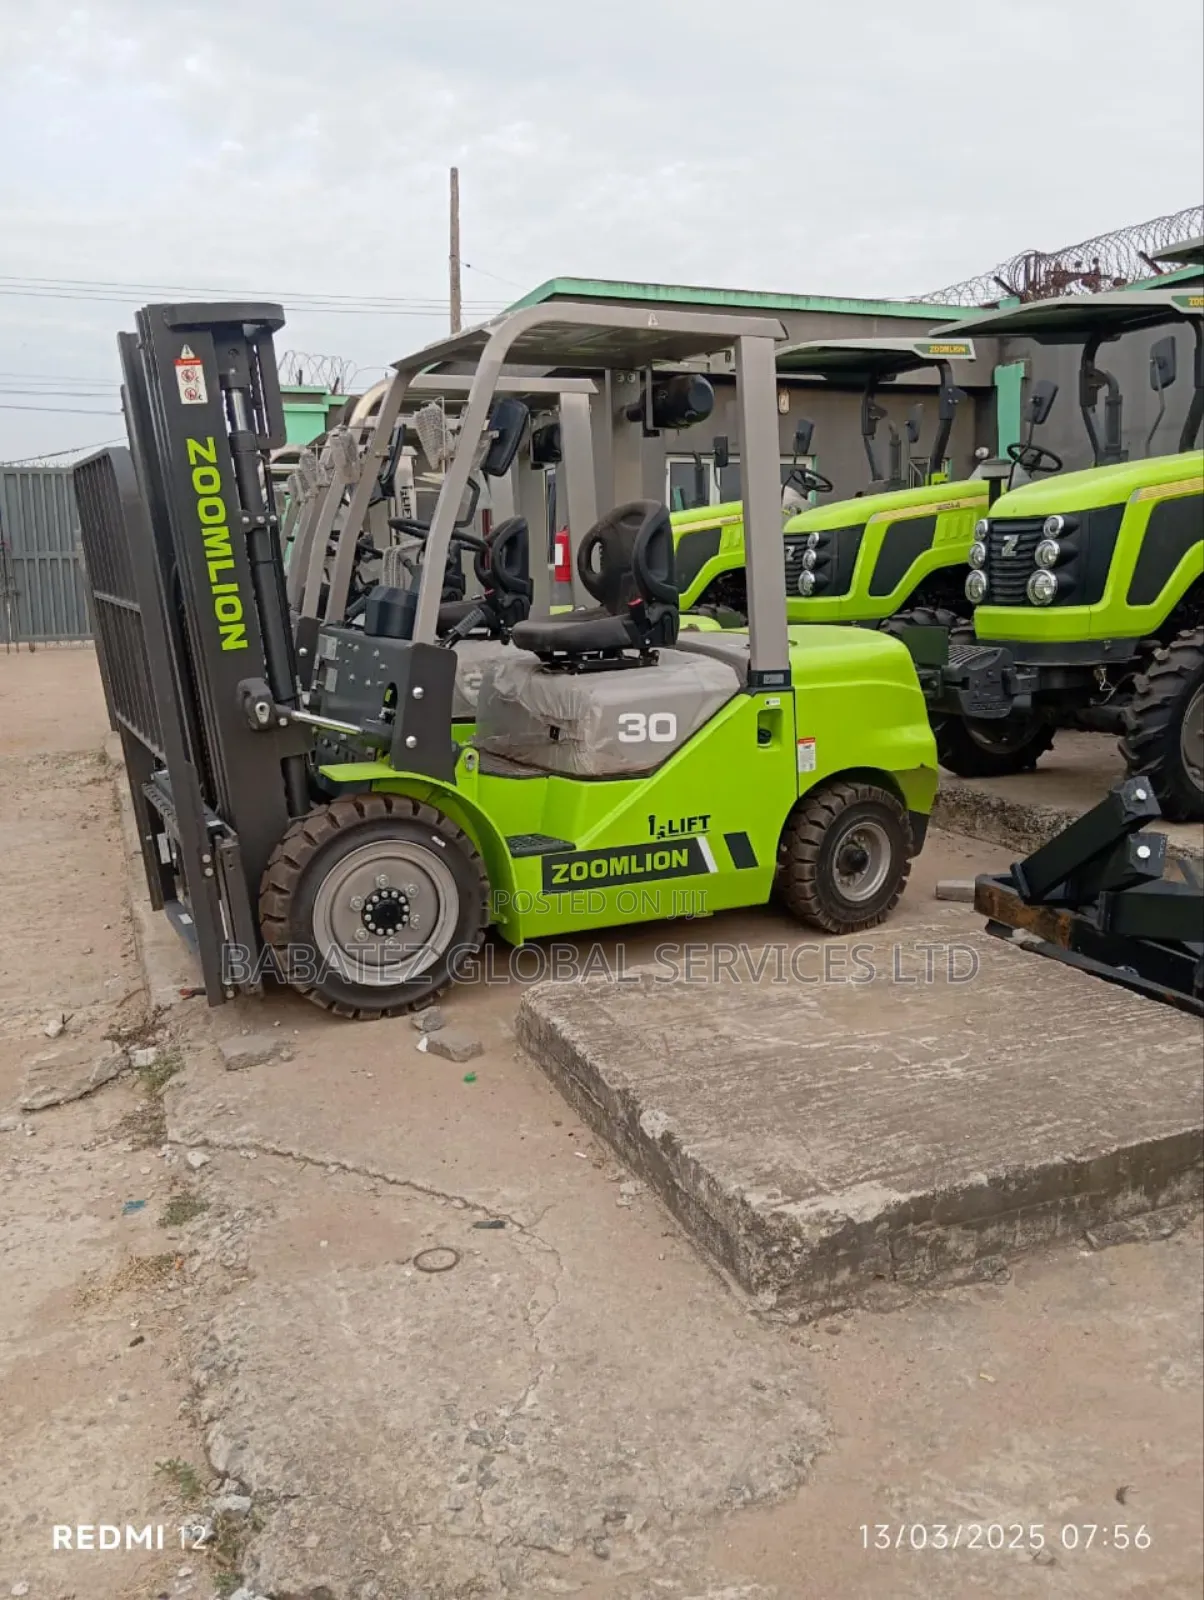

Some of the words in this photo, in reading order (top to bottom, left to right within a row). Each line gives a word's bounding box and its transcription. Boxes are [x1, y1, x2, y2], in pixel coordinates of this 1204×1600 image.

[185, 436, 249, 651] ZOOMLION
[618, 712, 677, 743] 30
[551, 848, 689, 885] ZOOMLION
